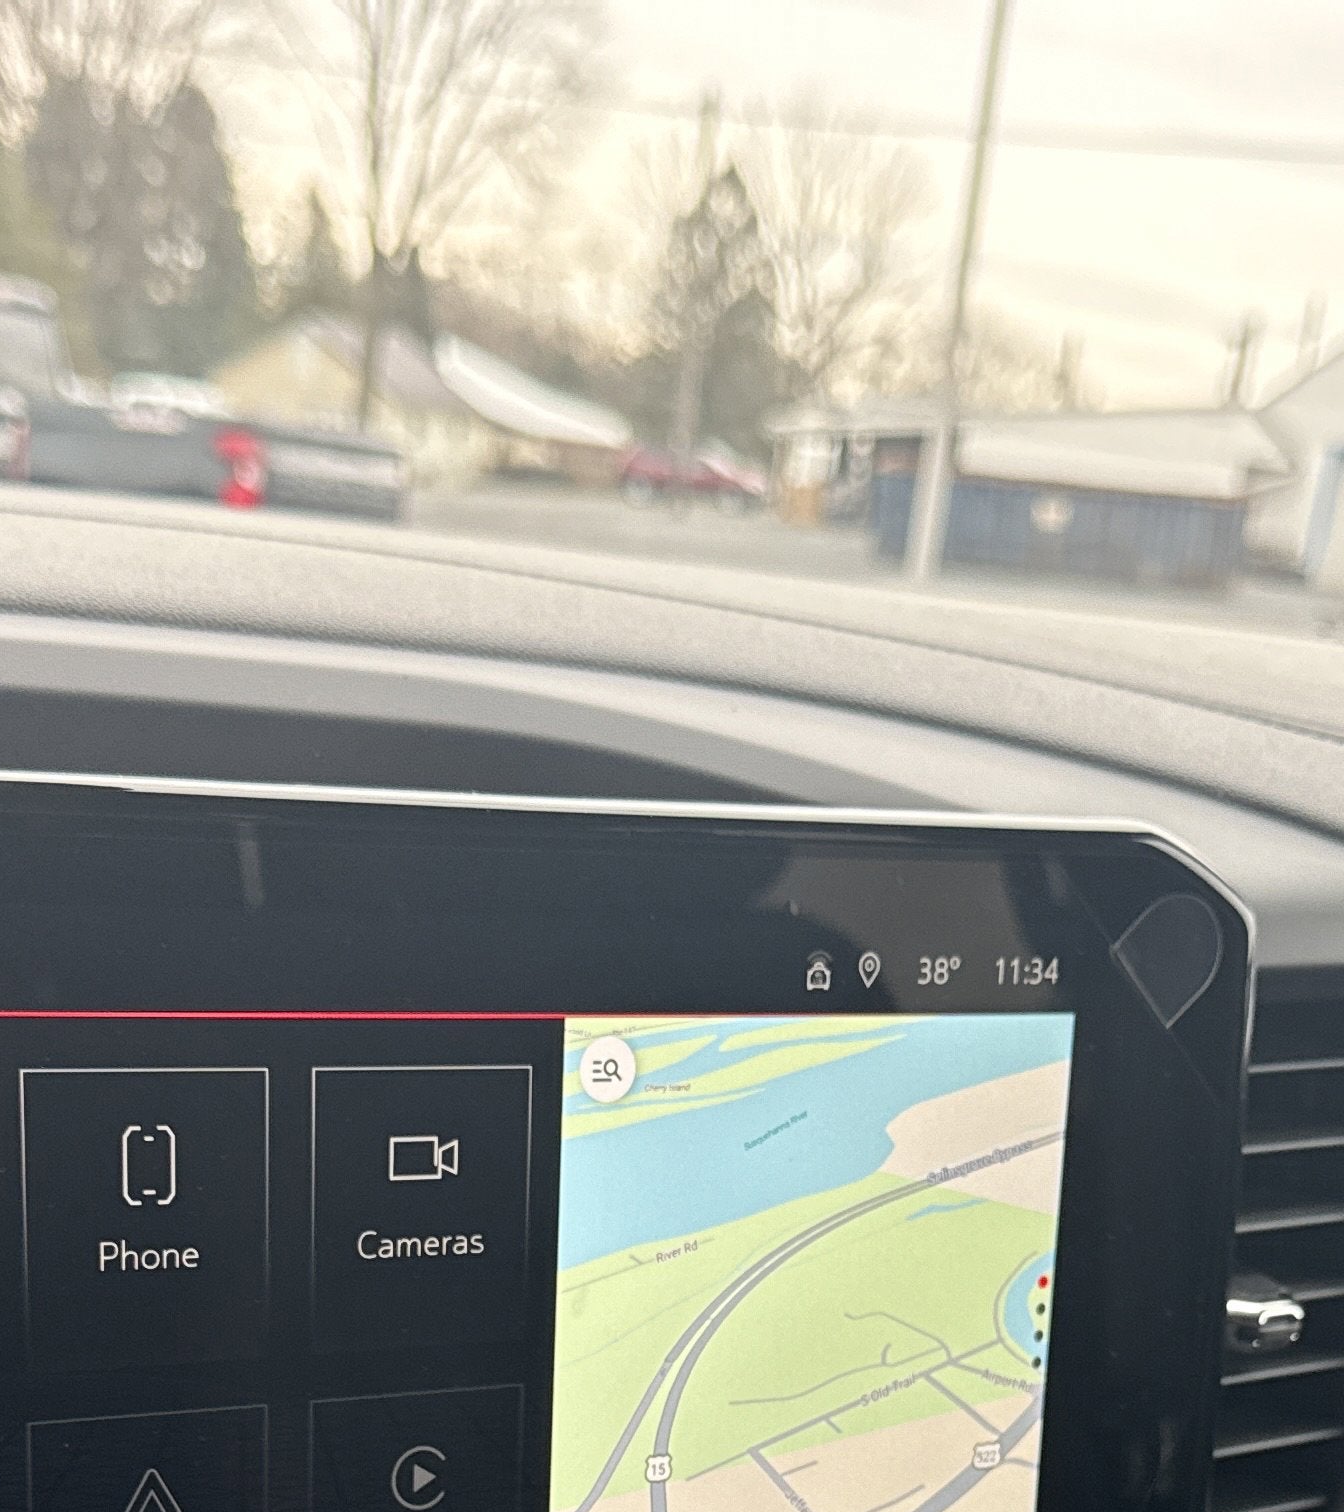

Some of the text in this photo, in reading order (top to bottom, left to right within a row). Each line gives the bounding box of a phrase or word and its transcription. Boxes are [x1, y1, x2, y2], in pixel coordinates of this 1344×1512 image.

[994, 955, 1059, 985] 11:34
[98, 1240, 199, 1272] Phone
[357, 1229, 485, 1261] Cameras
[655, 1239, 698, 1264] River Rd
[651, 1462, 666, 1476] 15
